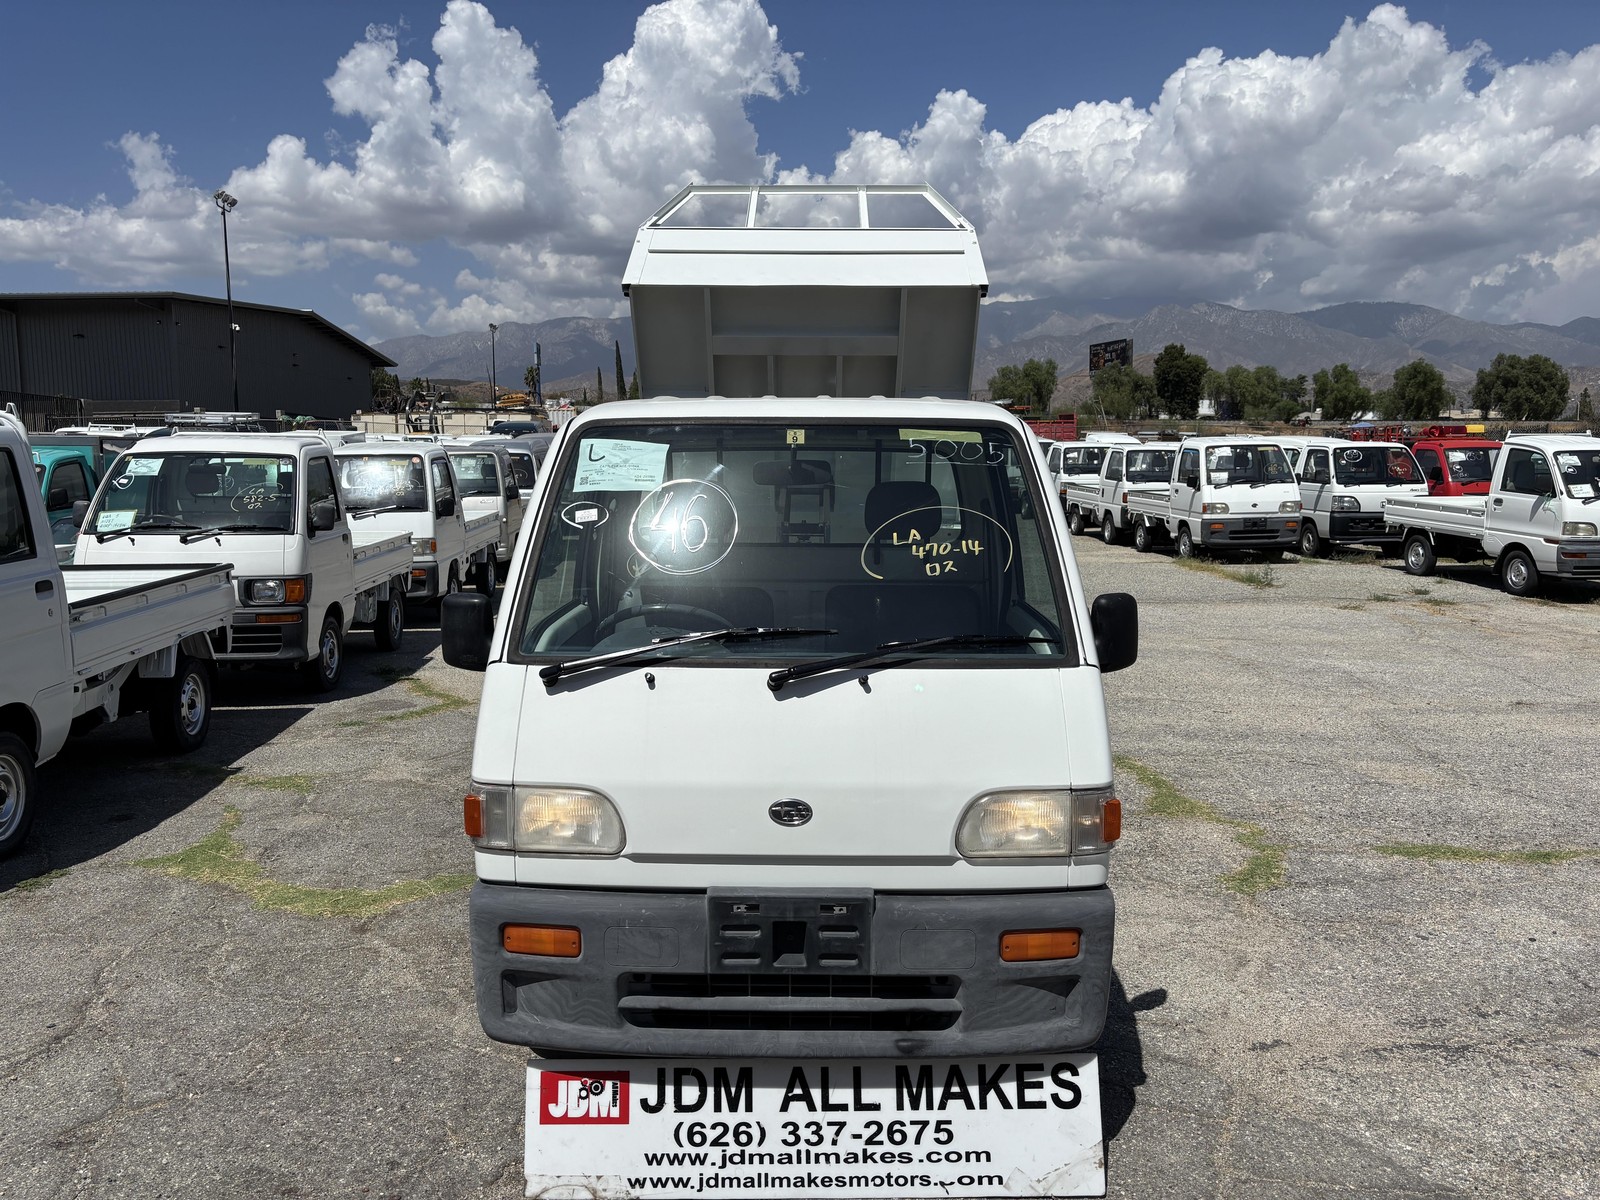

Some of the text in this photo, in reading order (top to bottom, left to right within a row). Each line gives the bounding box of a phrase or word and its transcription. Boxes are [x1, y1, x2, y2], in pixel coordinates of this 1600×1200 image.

[908, 438, 1004, 464] 5005
[650, 491, 709, 553] 46
[892, 528, 921, 546] LA
[911, 539, 985, 559] 470-14
[547, 1079, 620, 1118] JDM
[640, 1062, 1083, 1114] JDM ALL MAKES
[673, 1120, 954, 1147] (626) 337-2675
[644, 1148, 992, 1169] www.jdmallmakes.com
